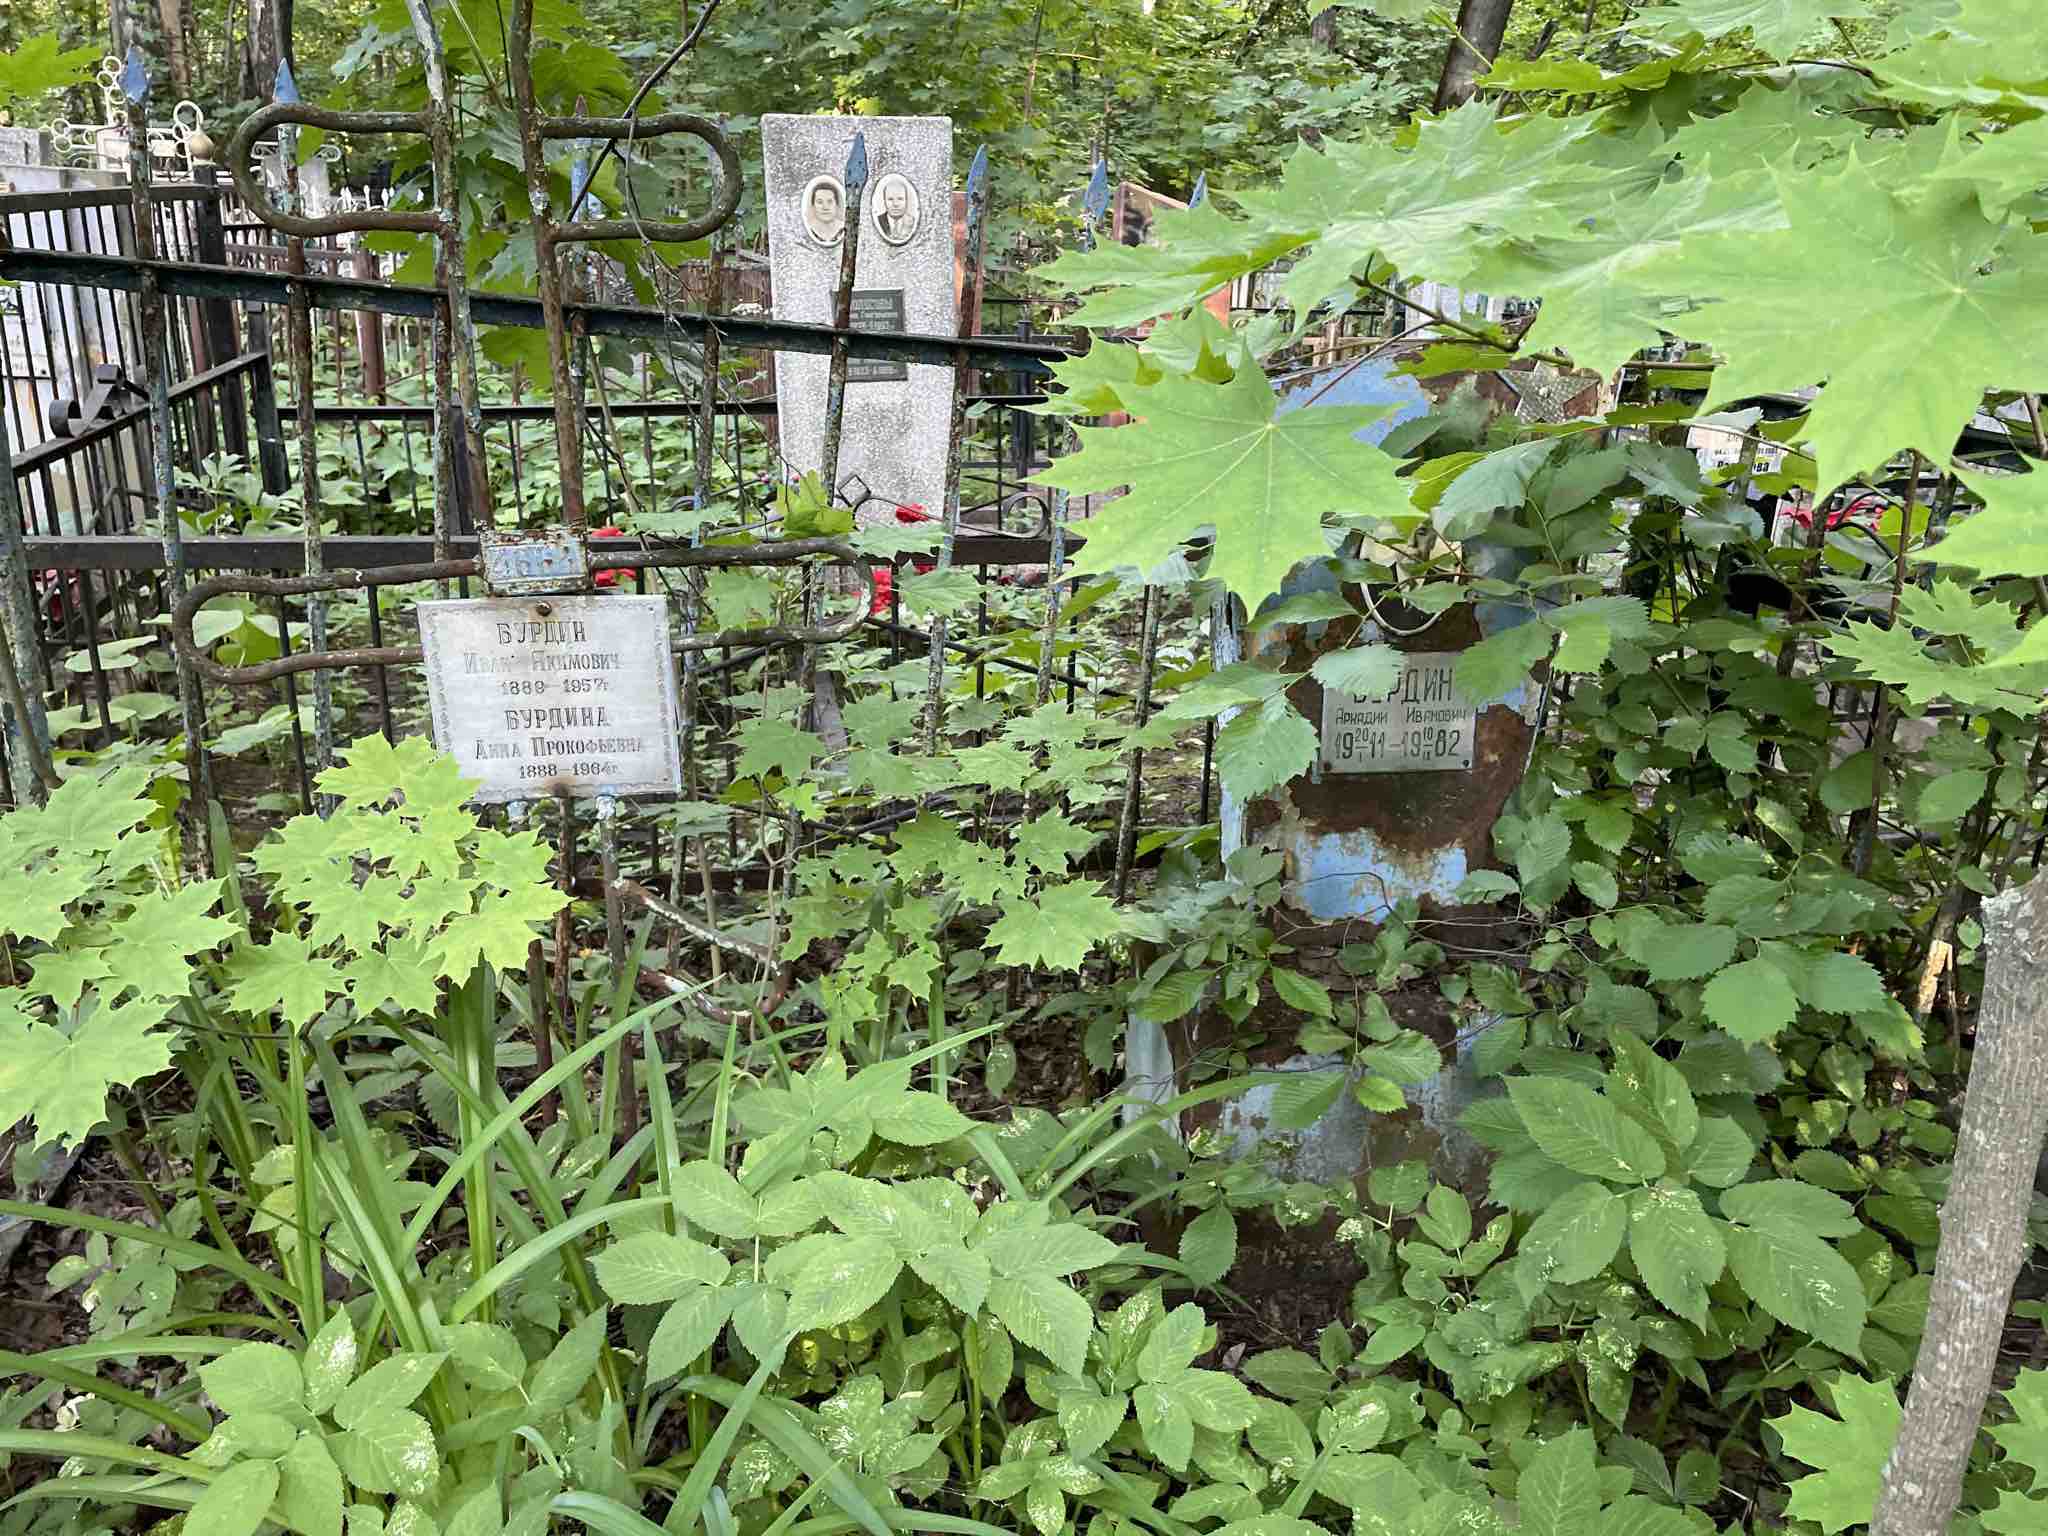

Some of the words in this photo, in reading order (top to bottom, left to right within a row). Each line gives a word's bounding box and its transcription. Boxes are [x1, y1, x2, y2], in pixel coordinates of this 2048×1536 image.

[497, 621, 586, 645] БУРДИН
[1353, 668, 1453, 704] РДИН
[504, 706, 611, 731] БУРДИНА
